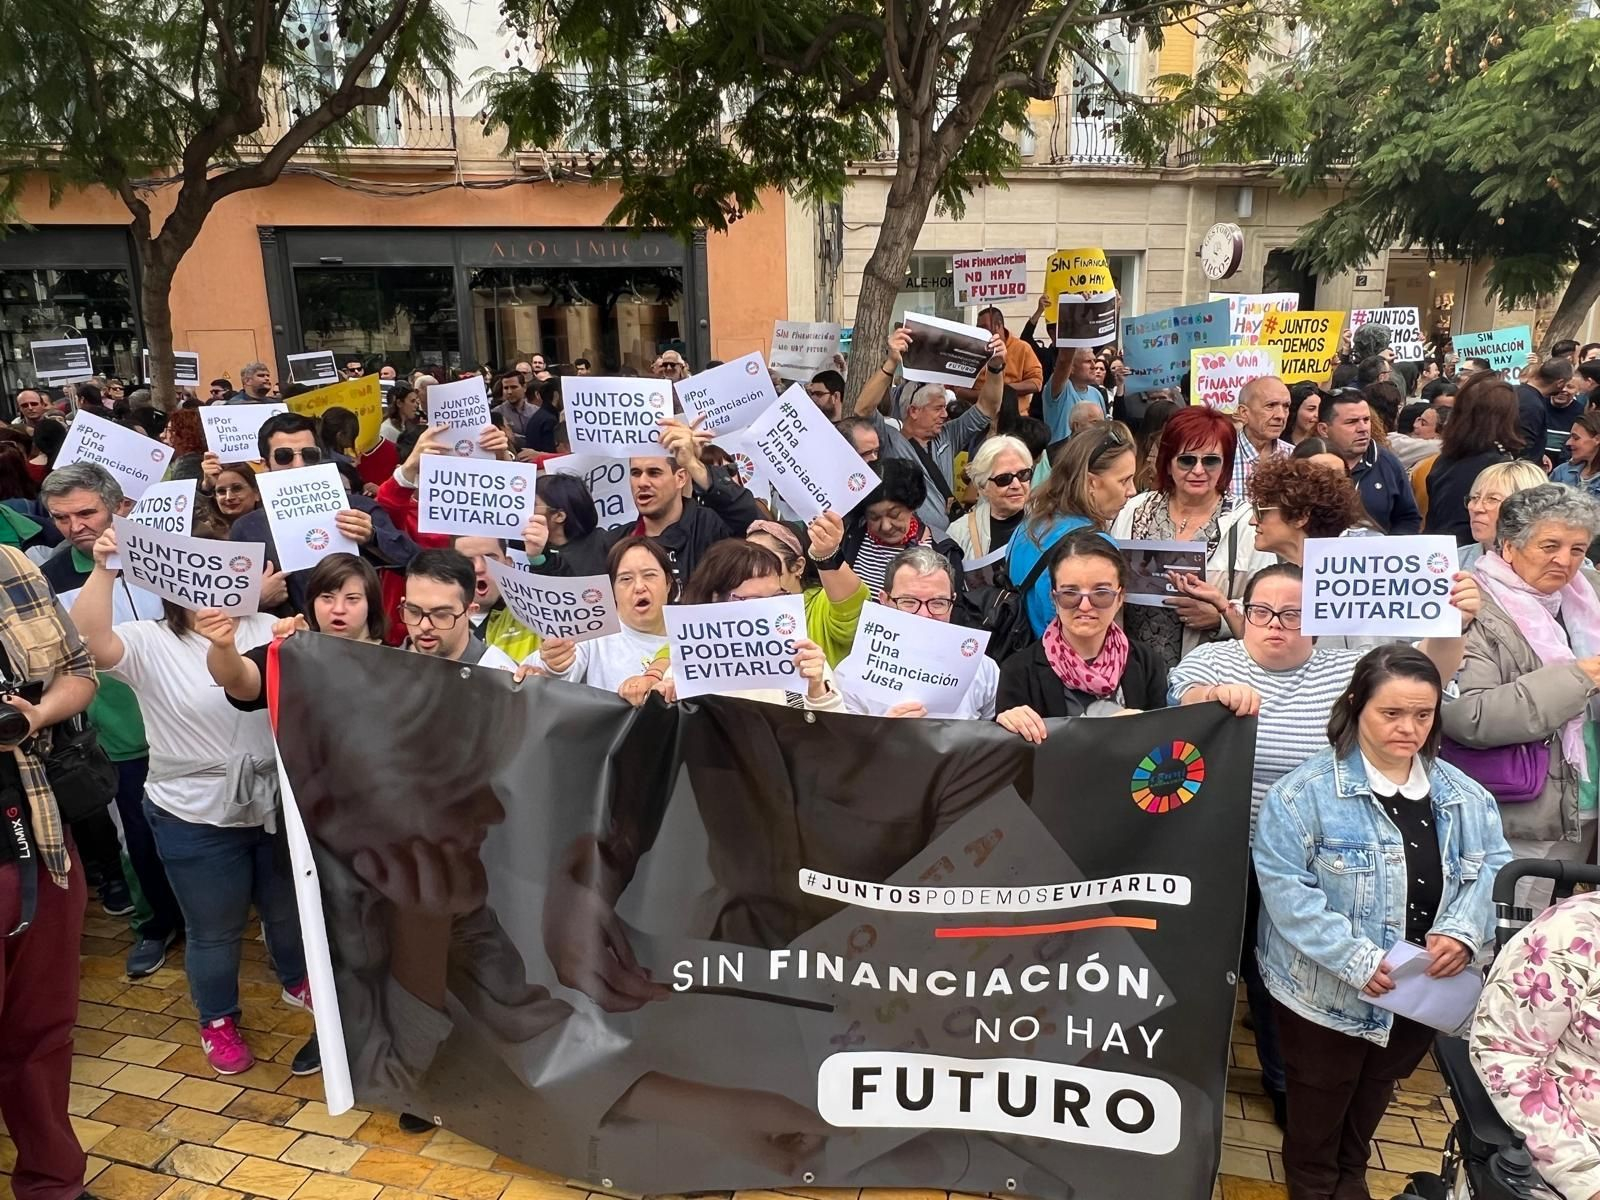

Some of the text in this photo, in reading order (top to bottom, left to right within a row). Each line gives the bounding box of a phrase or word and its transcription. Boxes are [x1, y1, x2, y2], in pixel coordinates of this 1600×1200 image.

[954, 258, 970, 268] SIN
[1051, 257, 1070, 272] SIN
[965, 269, 1012, 283] NO HAY
[1070, 274, 1105, 286] NO HAY
[971, 283, 1026, 297] FUTURO
[1235, 317, 1262, 334] HAY
[1352, 309, 1416, 325] #JUNTOS
[1477, 332, 1493, 342] SIN
[1457, 338, 1524, 357] FINANCIACIÓN
[948, 362, 975, 373] FUTURO
[1201, 355, 1258, 370] POR UNA
[1281, 358, 1331, 374] VITARLO
[1494, 355, 1512, 365] HAY
[441, 394, 480, 410] JUNTOS
[571, 391, 645, 408] JUNTOS
[684, 387, 708, 403] #Por
[693, 396, 716, 411] Una
[207, 416, 233, 426] #Por
[434, 404, 486, 420] PODEMOS
[573, 410, 665, 426] PODEMOS
[780, 401, 808, 434] #Por
[76, 424, 108, 440] #Por
[216, 426, 238, 434] Una
[702, 414, 731, 431] Justa
[80, 436, 105, 452] Una
[218, 432, 257, 443] Financi
[576, 427, 660, 444] EVITARLO
[776, 419, 799, 449] Una
[220, 442, 249, 453] Justa
[757, 440, 787, 475] Justa
[76, 445, 149, 481] Financiación
[766, 428, 832, 510] Financiación
[277, 480, 331, 497] JUNTOS
[428, 470, 505, 490] JUNTOS
[271, 489, 341, 509] PODEMOS
[429, 488, 525, 510] PODEMOS
[594, 494, 624, 517] na
[276, 500, 342, 520] EVITARLO
[429, 506, 520, 527] EVITARLO
[127, 535, 223, 571] JUNTOS
[129, 550, 249, 590] PODEMOS
[1315, 554, 1421, 574] JUNTOS
[132, 566, 242, 608] EVITARLO
[500, 576, 577, 606] JUNTOS
[1315, 577, 1449, 597] PODEMOS
[503, 590, 606, 622] PODEMOS
[1314, 601, 1441, 620] EVITARLO
[511, 605, 603, 639] EVITARLO
[677, 618, 770, 641] JUNTOS
[863, 621, 901, 642] #Por
[680, 638, 798, 661] PODEMOS
[870, 638, 900, 659] Una
[684, 659, 795, 681] EVITARLO
[861, 669, 904, 691] Justa
[866, 653, 959, 687] Financiación
[12, 818, 30, 858] LUMIX
[806, 872, 1177, 905] #JUNTOSPODEMOSEVITARLO
[672, 949, 1166, 1006] SIN FINANCIACIÓN,
[975, 1014, 1165, 1059] NO HAY
[851, 1066, 1156, 1134] FUTURO
